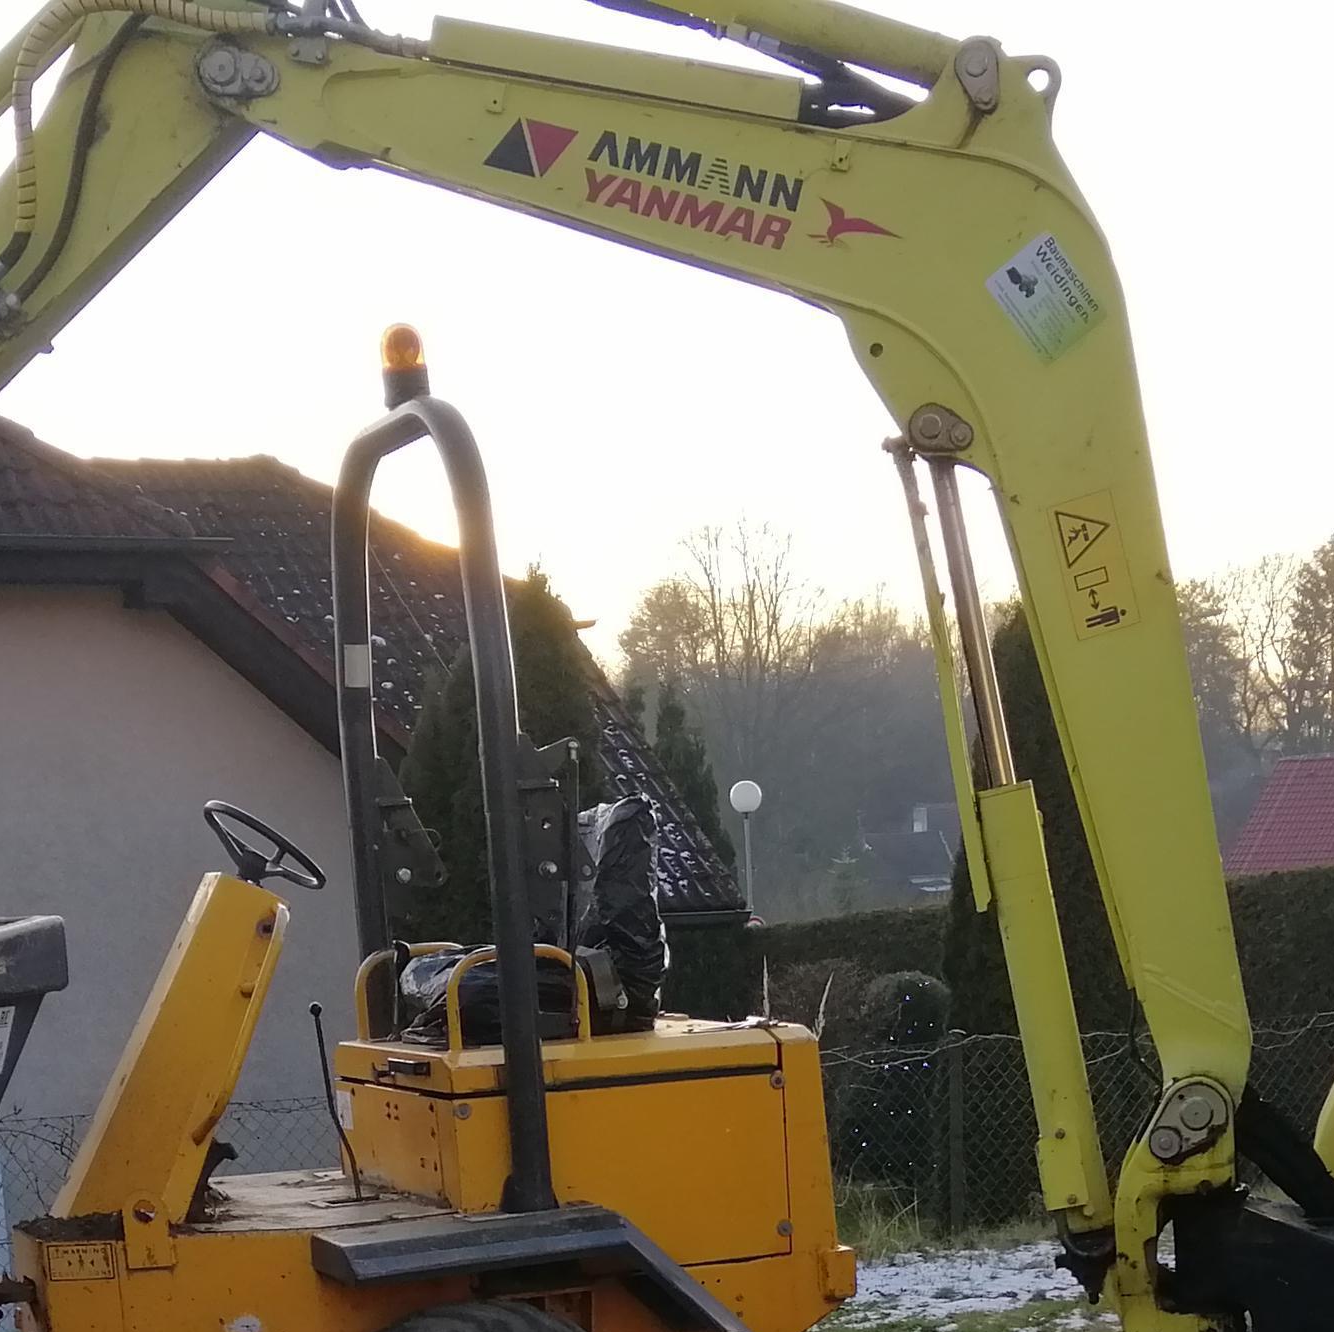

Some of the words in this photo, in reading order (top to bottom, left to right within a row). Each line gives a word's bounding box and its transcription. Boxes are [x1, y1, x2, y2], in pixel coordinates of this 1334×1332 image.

[584, 167, 793, 251] YANMAR
[586, 130, 804, 213] AMMANN
[1043, 236, 1100, 313] Baumaschinen
